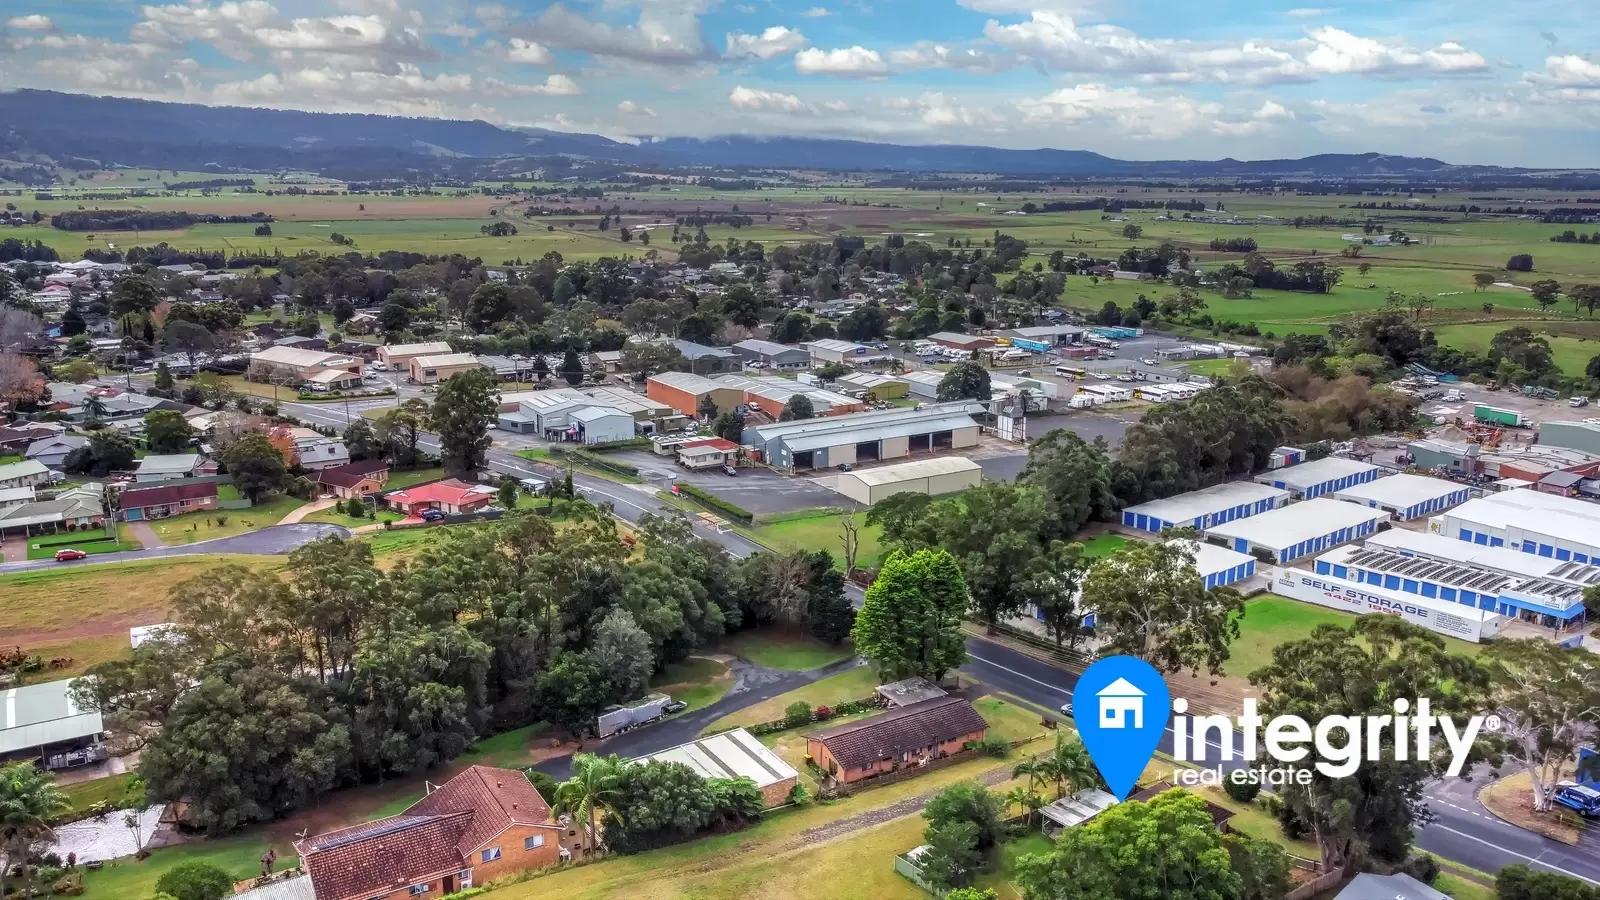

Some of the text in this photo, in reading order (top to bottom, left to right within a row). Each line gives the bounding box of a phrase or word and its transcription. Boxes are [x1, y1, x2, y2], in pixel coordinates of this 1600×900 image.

[1301, 577, 1341, 593] SELF
[1345, 589, 1429, 618] STORAGE
[1323, 592, 1362, 606] 4422
